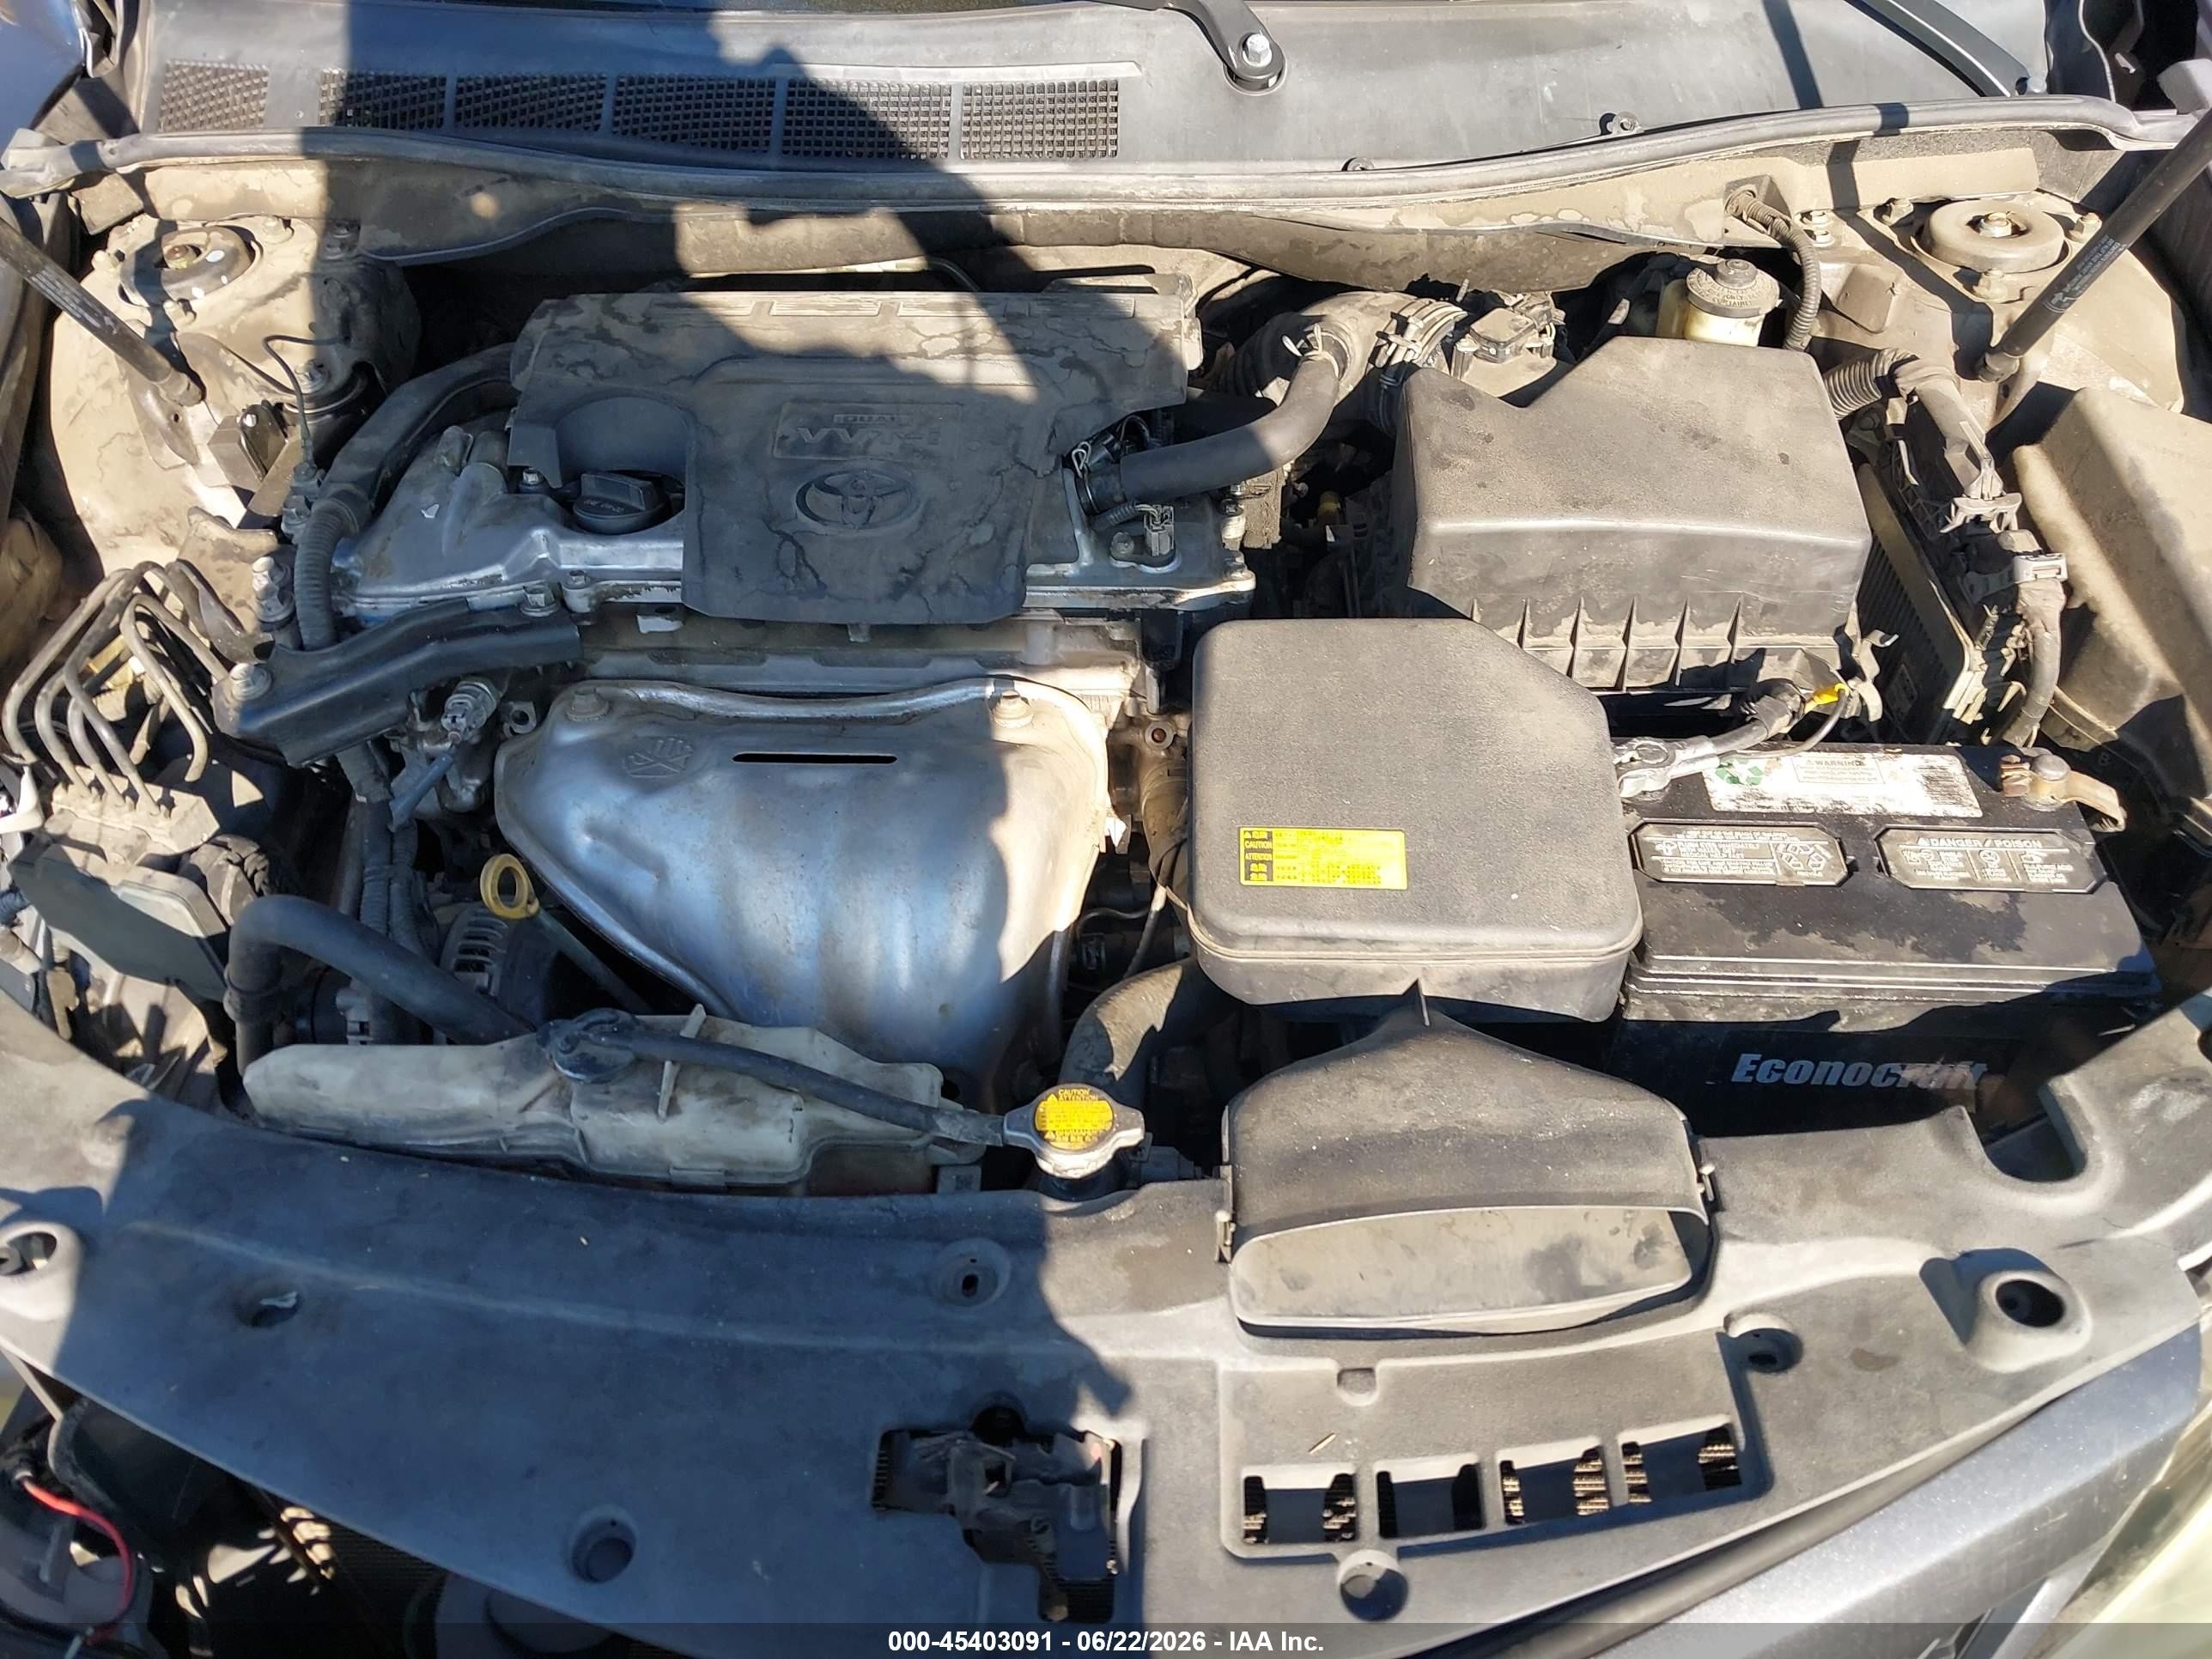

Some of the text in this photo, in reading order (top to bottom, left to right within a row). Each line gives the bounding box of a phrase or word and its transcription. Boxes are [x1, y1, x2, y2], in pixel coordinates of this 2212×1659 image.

[1245, 841, 1273, 849] CAUTION
[1930, 837, 1984, 848] DANGER
[1993, 838, 2043, 848] POISON
